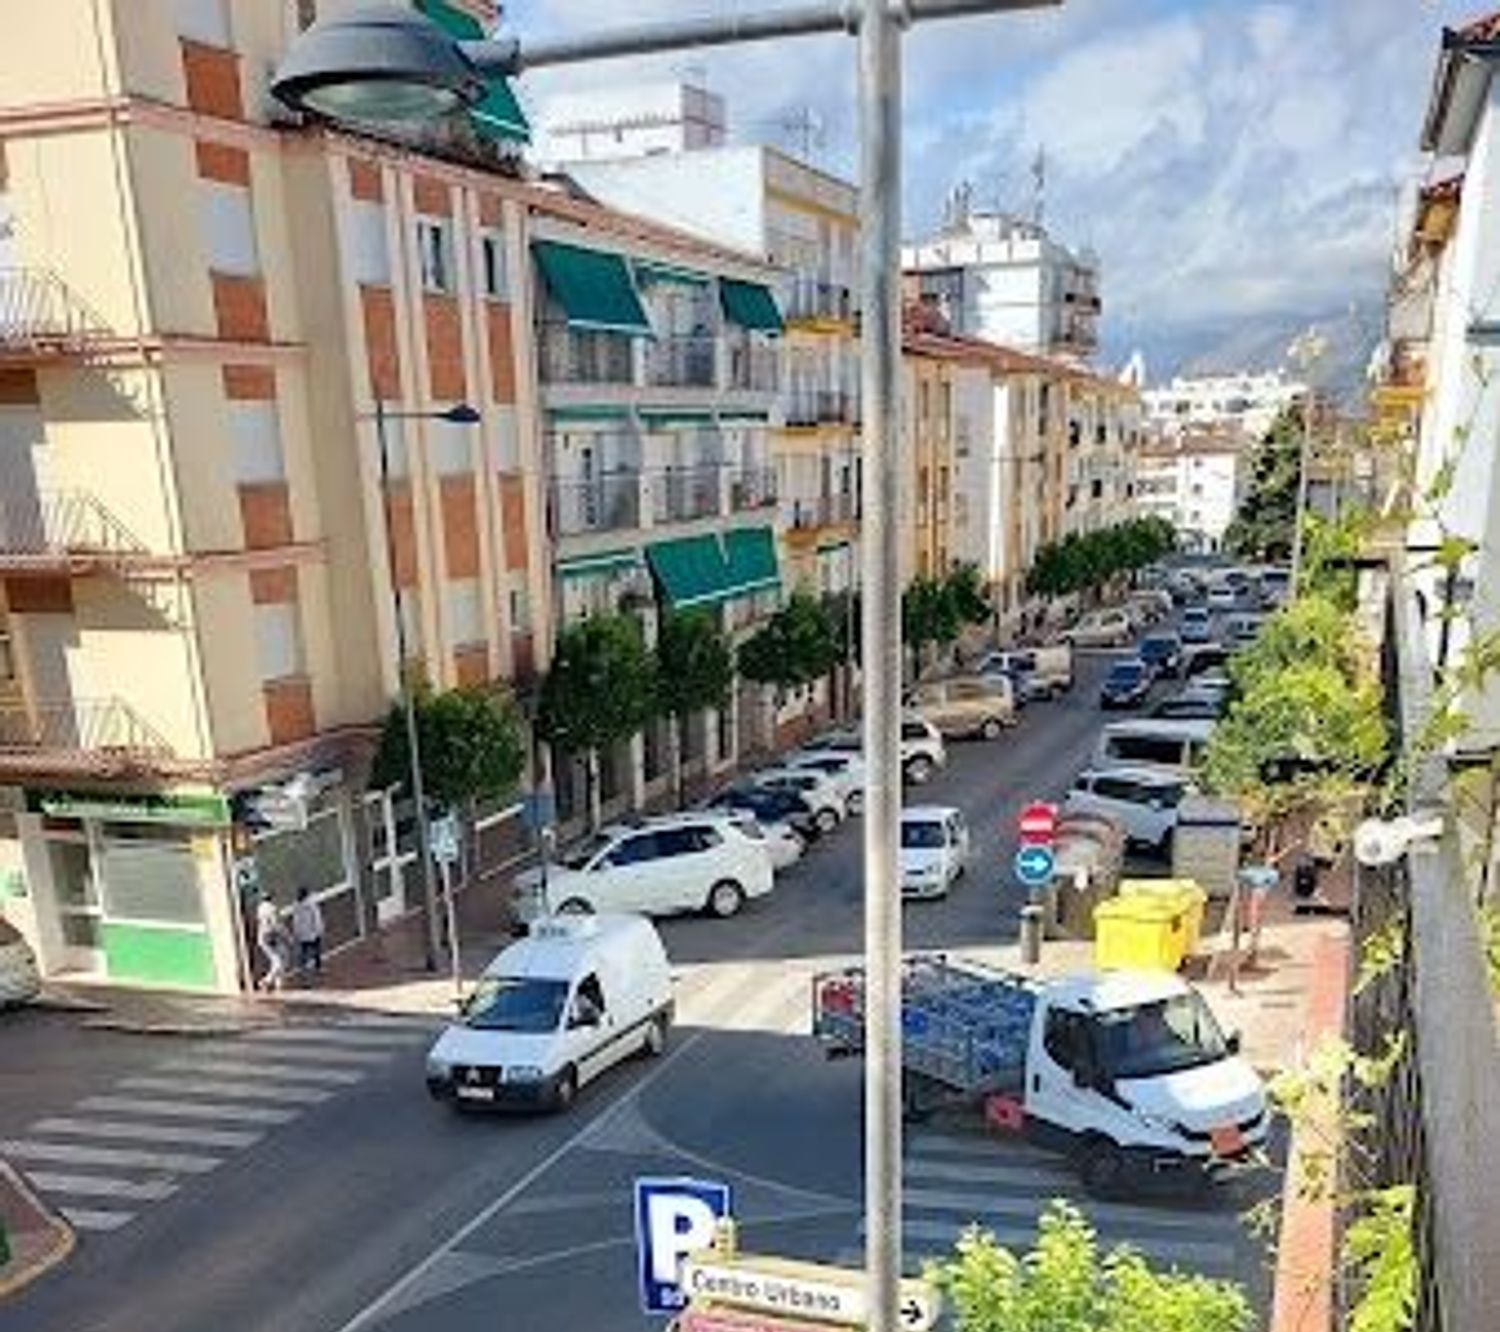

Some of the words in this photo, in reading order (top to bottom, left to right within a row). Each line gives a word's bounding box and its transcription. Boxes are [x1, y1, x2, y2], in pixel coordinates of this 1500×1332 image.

[648, 1194, 717, 1282] P
[692, 1269, 759, 1298] Centro
[764, 1280, 841, 1311] Urbano
